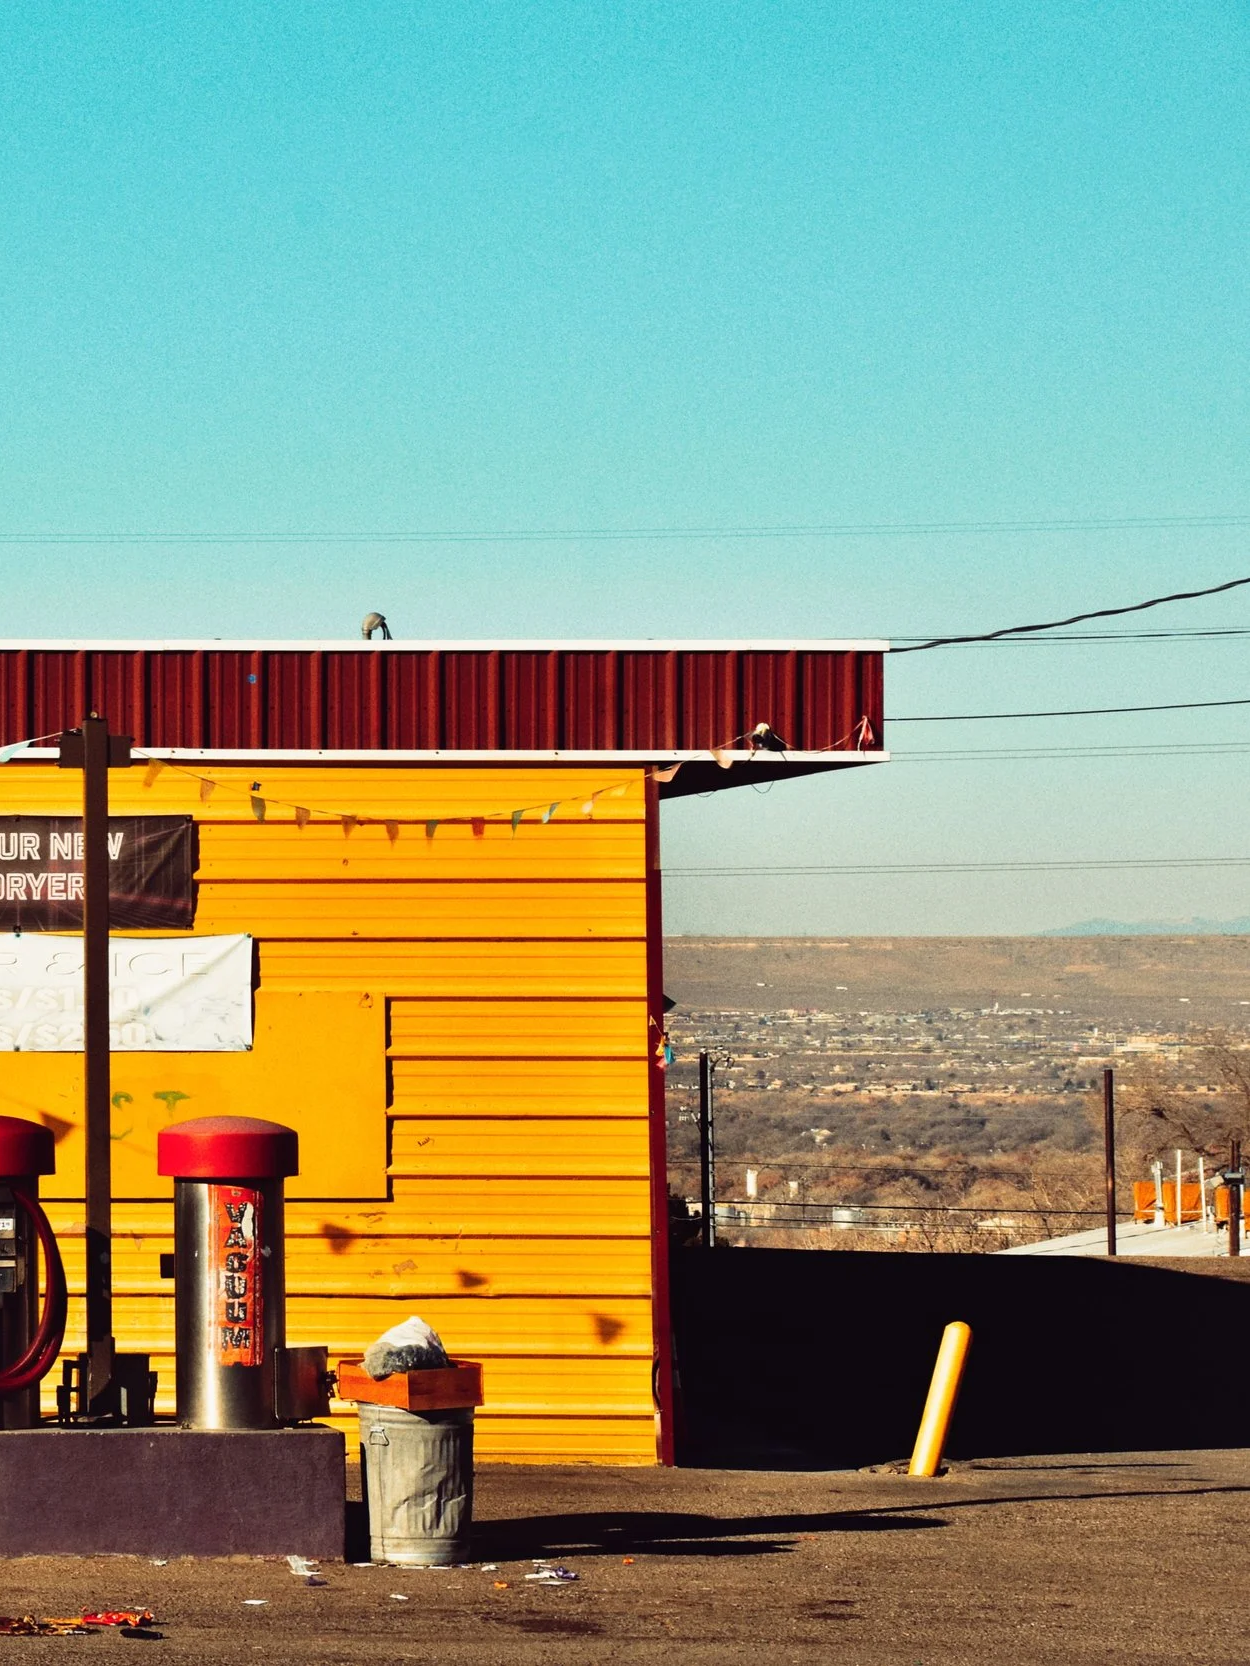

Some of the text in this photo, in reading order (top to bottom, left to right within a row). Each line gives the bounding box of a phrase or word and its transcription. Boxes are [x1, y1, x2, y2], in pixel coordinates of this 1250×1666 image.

[45, 951, 85, 977] &
[113, 951, 209, 977] ICE
[221, 1202, 251, 1351] VACUUM
